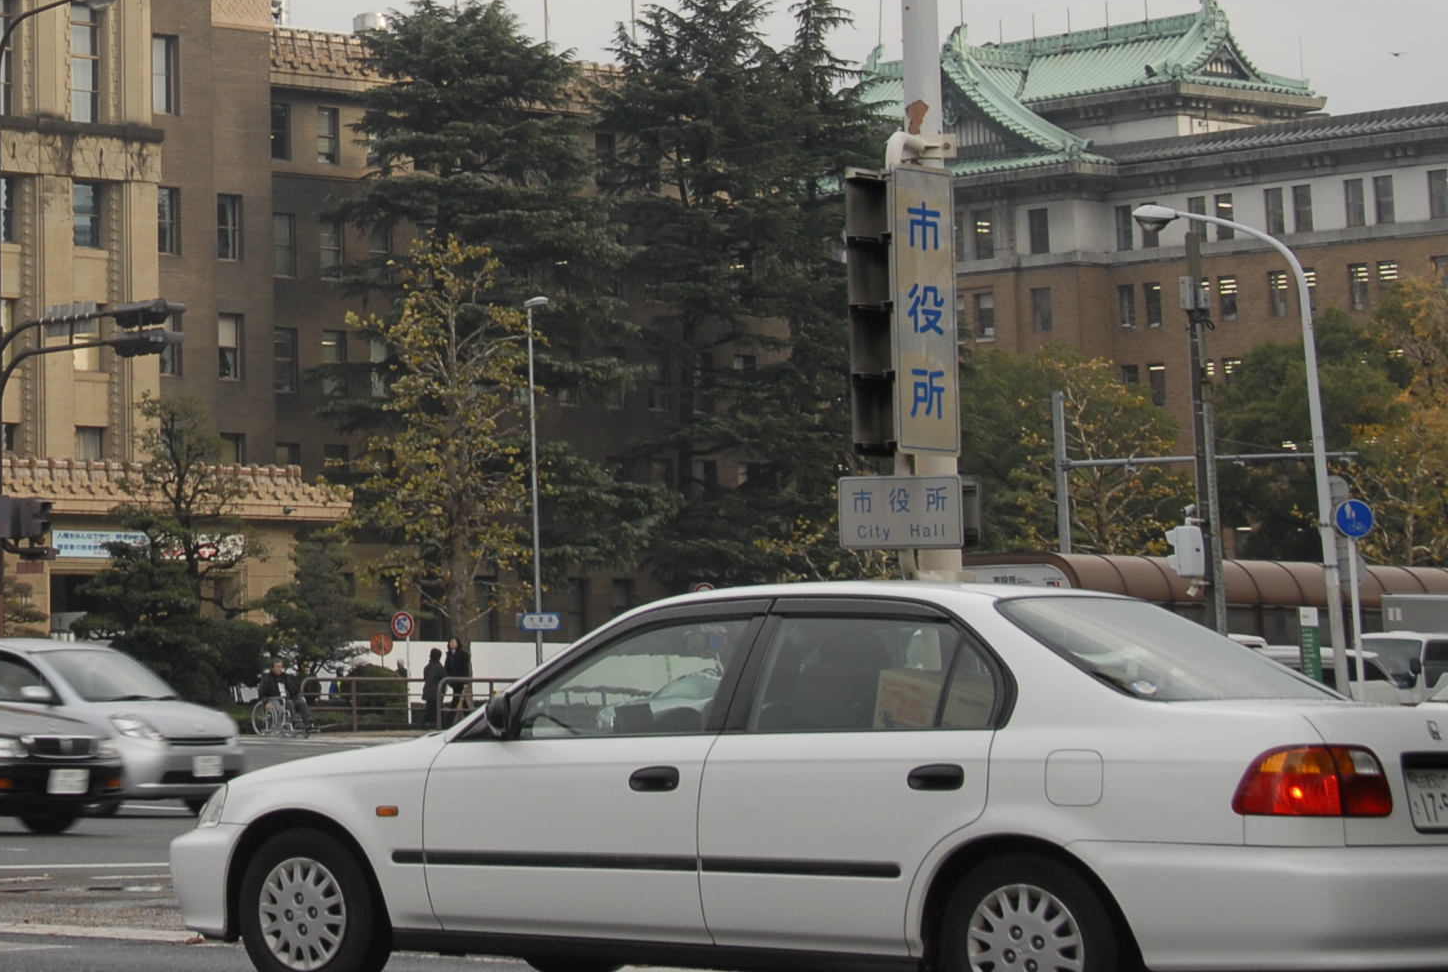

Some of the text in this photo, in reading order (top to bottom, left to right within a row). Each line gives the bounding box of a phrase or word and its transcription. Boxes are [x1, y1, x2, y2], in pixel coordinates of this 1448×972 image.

[906, 201, 946, 420] 市役所
[852, 486, 947, 514] 市役所
[857, 523, 945, 542] City Hall
